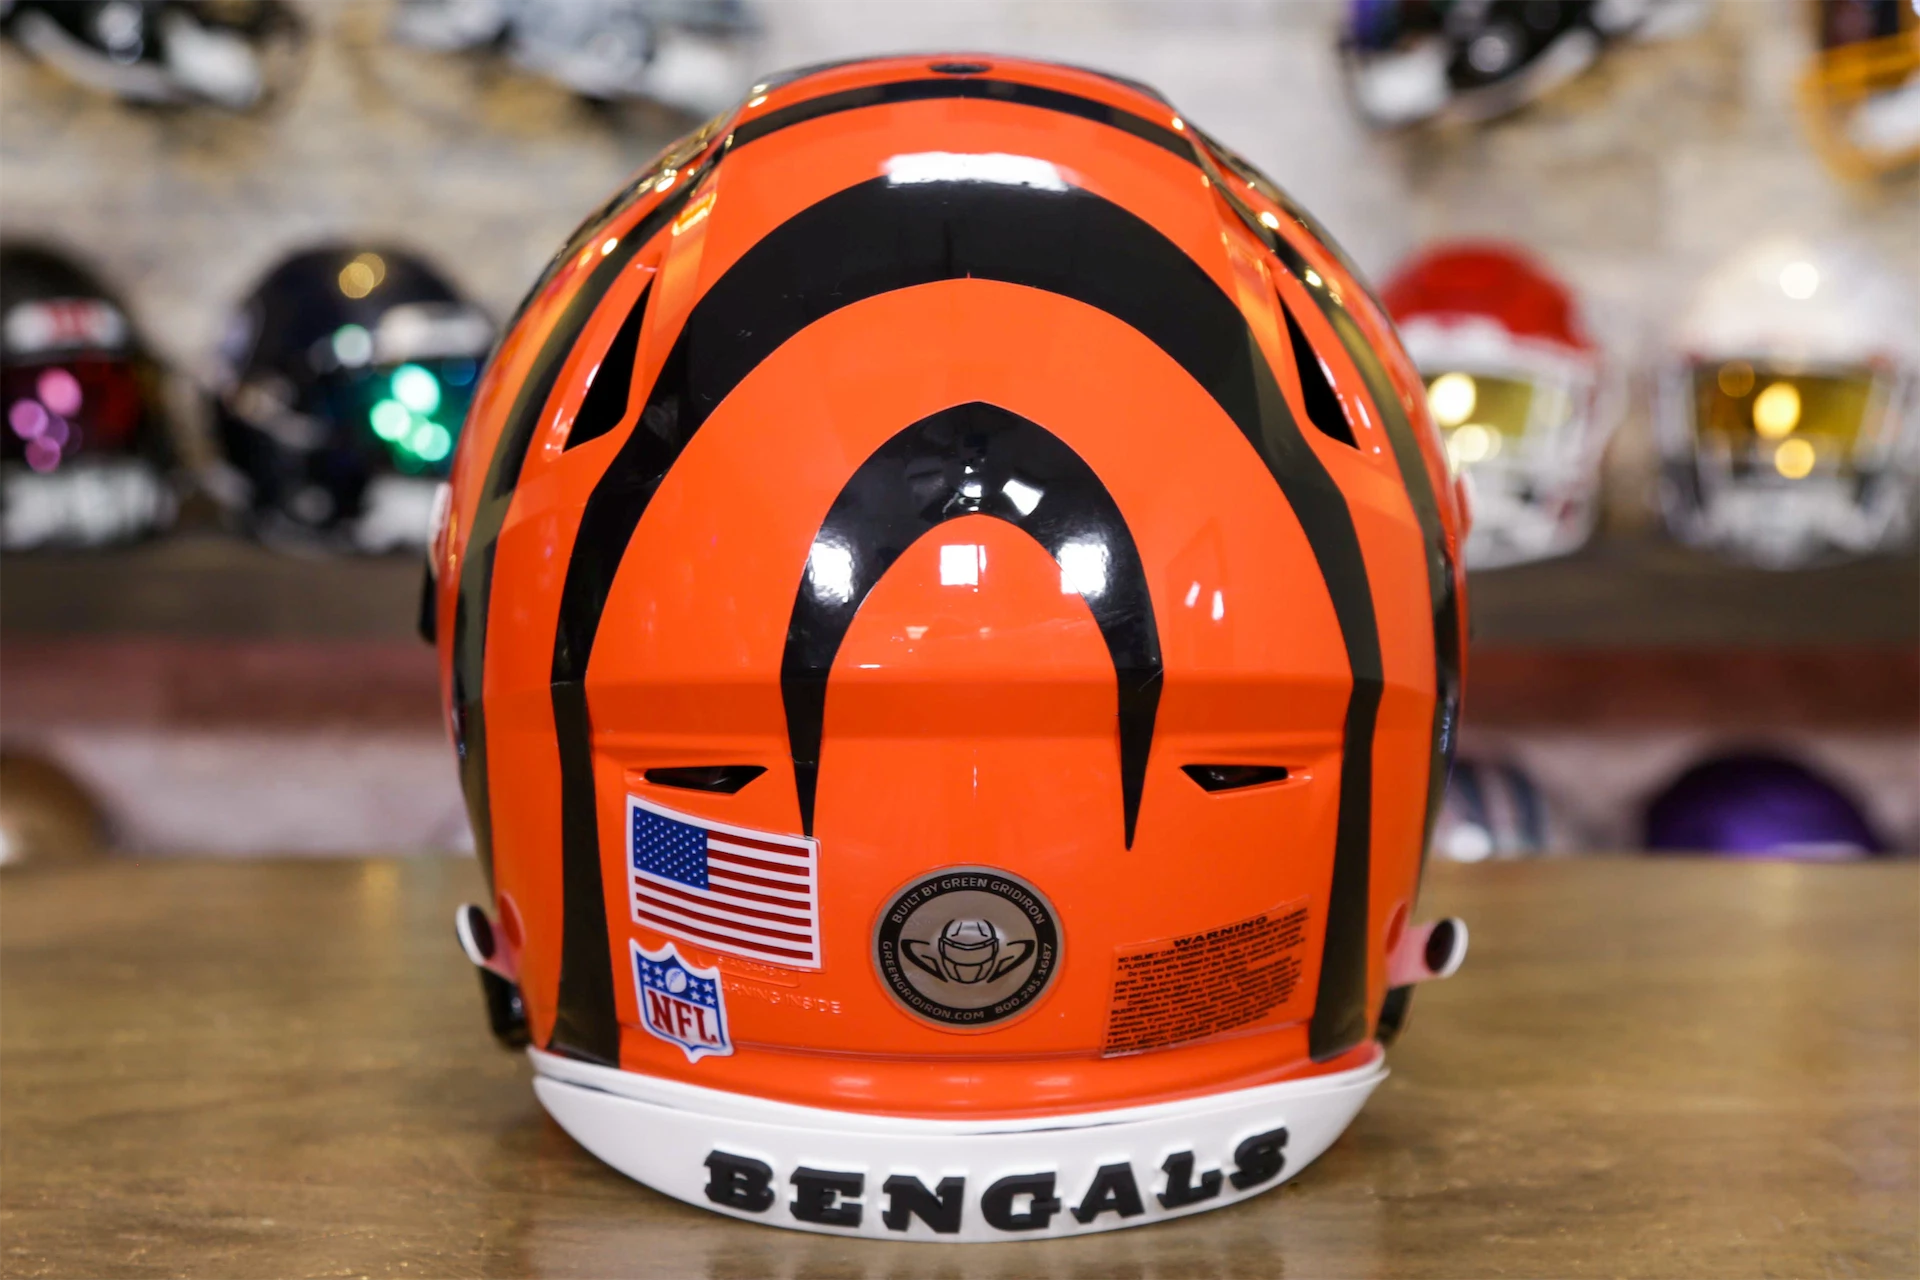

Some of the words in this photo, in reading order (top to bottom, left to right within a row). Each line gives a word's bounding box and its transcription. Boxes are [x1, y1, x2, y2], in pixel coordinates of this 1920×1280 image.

[892, 892, 920, 923] BUILT
[921, 883, 938, 897] BY
[941, 877, 988, 889] GREEN
[990, 881, 1045, 925] GRIDIRON
[1174, 915, 1268, 947] WARNING
[722, 981, 780, 1004] ARNING
[784, 993, 842, 1015] INSIDE
[882, 940, 985, 1021] GREENGRIDIRON.COM
[648, 990, 718, 1045] NFL
[703, 1127, 1290, 1234] BENGALS
